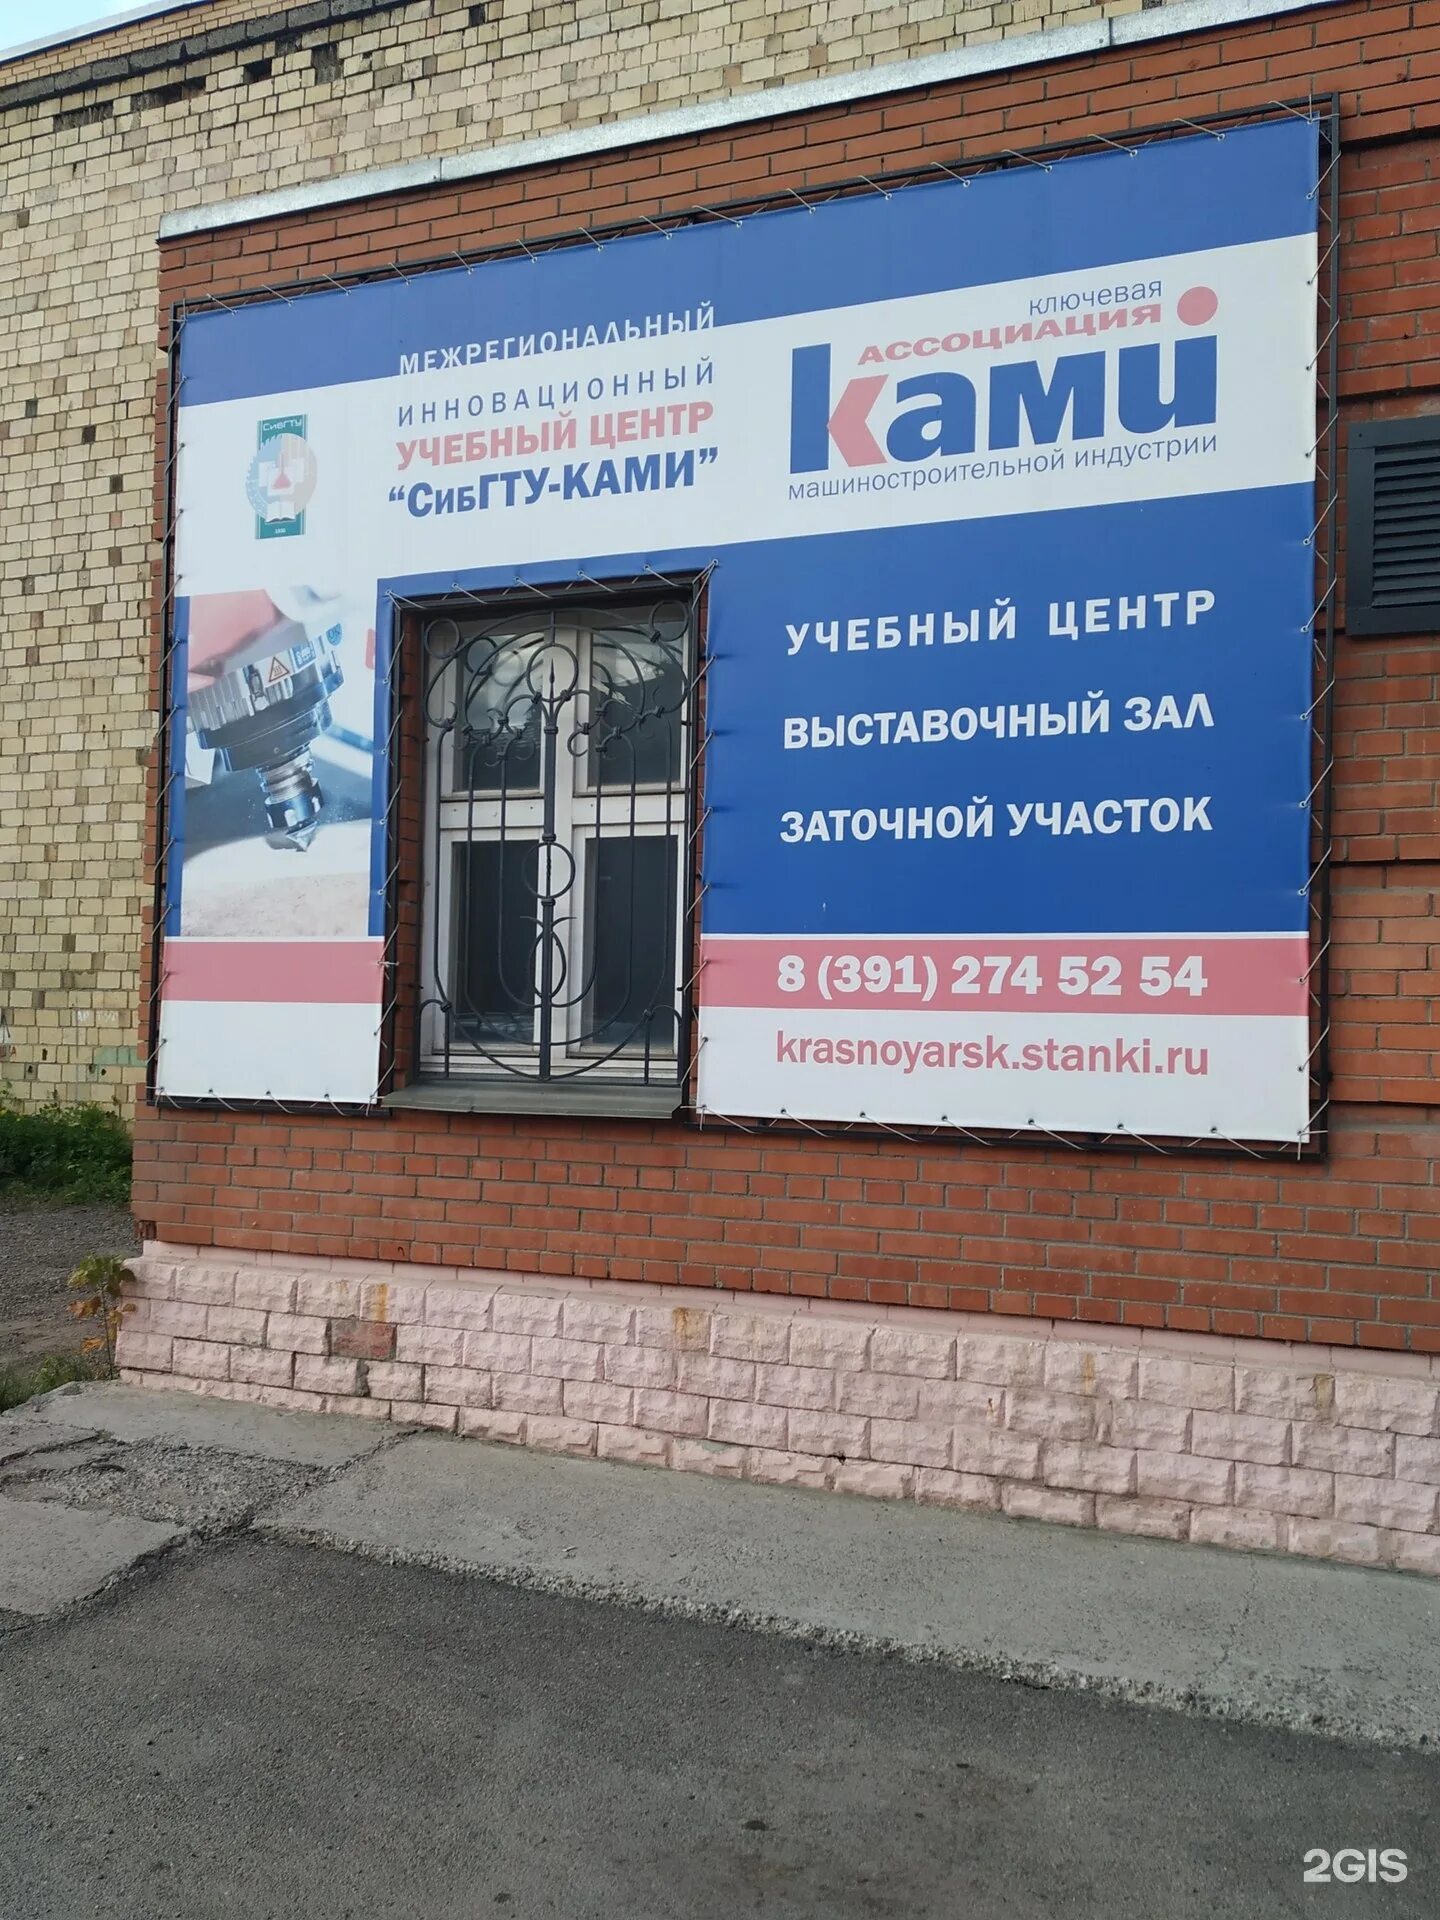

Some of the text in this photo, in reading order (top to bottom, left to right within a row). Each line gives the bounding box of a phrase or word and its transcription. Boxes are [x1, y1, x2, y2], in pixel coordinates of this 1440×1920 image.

[1029, 280, 1162, 316] ключевая
[399, 300, 715, 375] МЕЖРЕГИОНАЛЬНЫЙ
[857, 303, 1162, 366] АССОЦИАЦИЯ
[398, 355, 714, 427] ИННОВАЦИОННЫЙ
[396, 401, 714, 471] УЧЕБНЫЙ ЦЕНТР
[788, 434, 1217, 501] машиностроительной индустрии
[785, 589, 1216, 656] УЧЕБНЫЙ ЦЕНТР
[783, 689, 1215, 750] ВЫСТАВОЧНЫЙ ЗАЛ
[779, 795, 1214, 844] ЗАТОЧНОЙ УЧАСТОК
[777, 955, 1208, 1002] 8 (391) 274 52 54
[776, 1029, 1209, 1076] krasnoyarsk.stanki.ru
